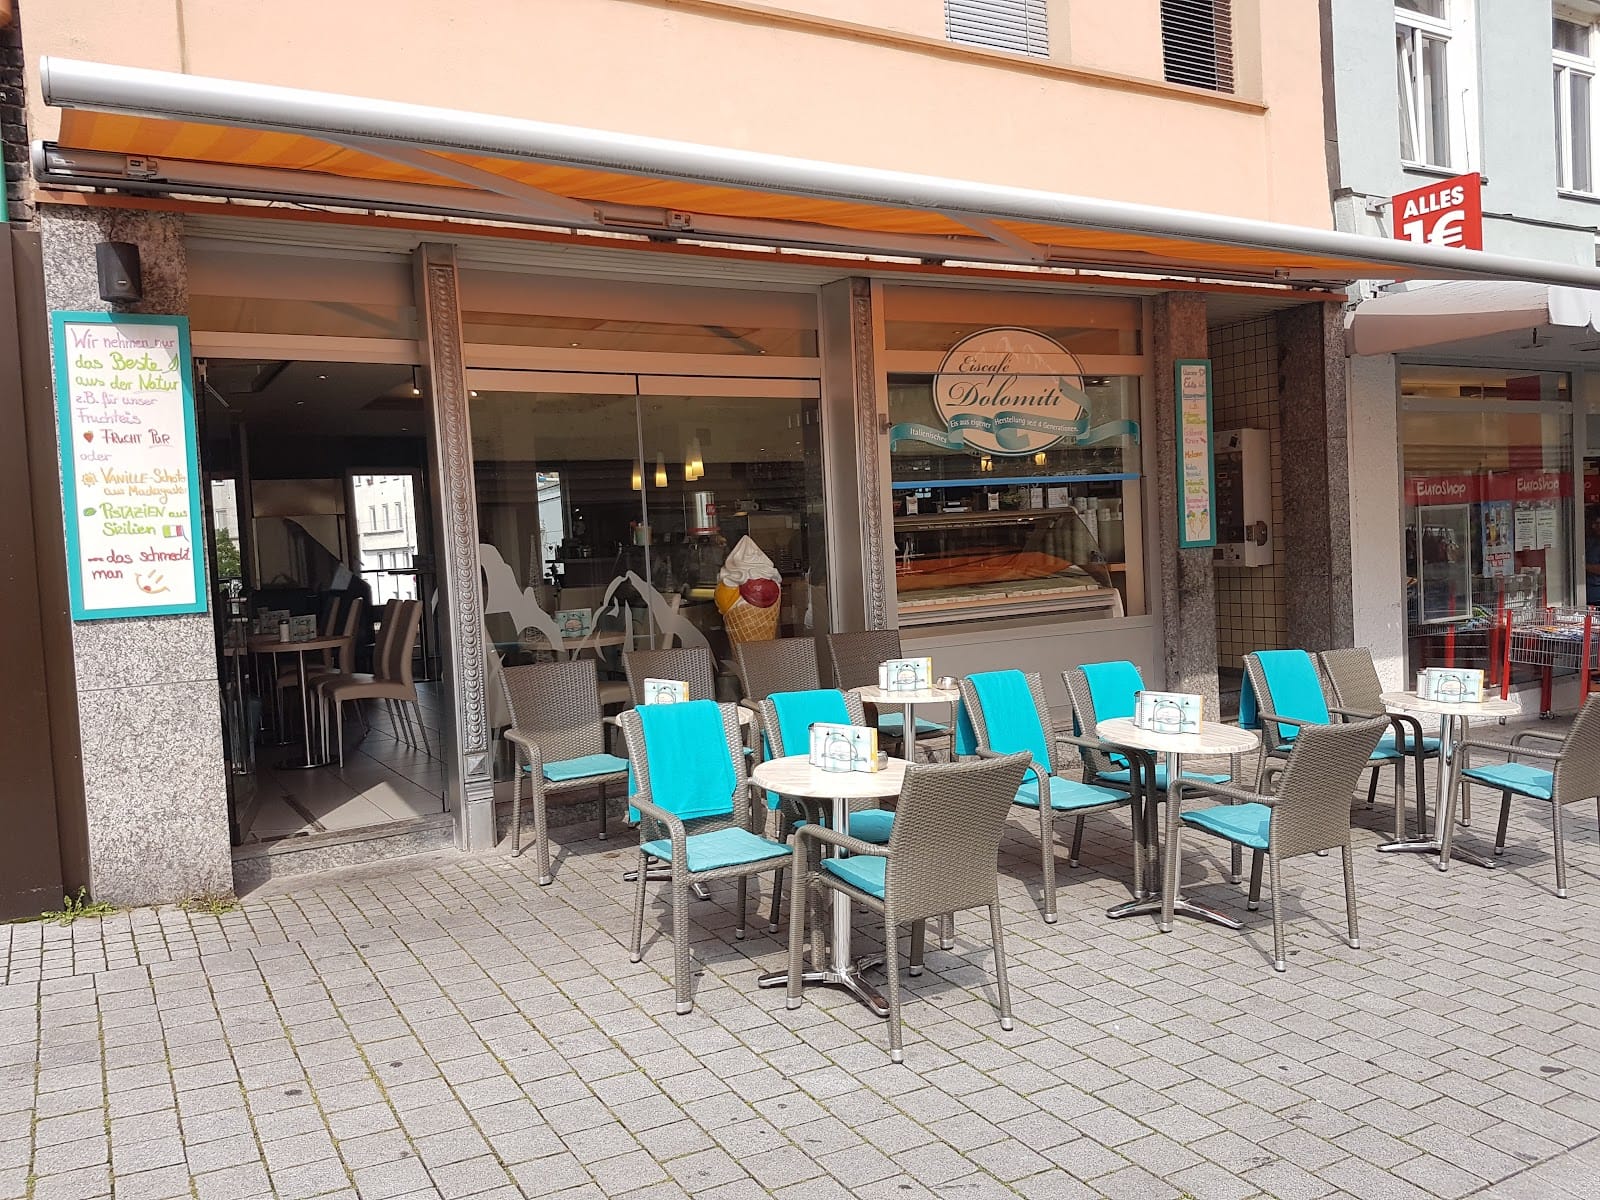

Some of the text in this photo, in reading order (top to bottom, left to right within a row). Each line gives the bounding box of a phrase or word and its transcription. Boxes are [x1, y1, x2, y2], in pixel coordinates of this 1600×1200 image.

[1403, 186, 1464, 219] ALLES
[71, 328, 175, 349] Wir nehmen nur
[75, 352, 162, 371] das Beste
[958, 352, 1013, 387] Eiscafé
[75, 374, 179, 391] aus der Natur
[945, 374, 1063, 407] Dolomiti
[102, 391, 117, 408] für
[122, 396, 158, 406] unser
[76, 408, 141, 424] Fruchteis
[909, 427, 947, 444] Italienisches
[80, 450, 112, 461] oder
[1416, 479, 1467, 496] EuroShop
[1517, 477, 1560, 492] EuroShop
[103, 521, 157, 536] Sizilien
[106, 546, 191, 564] das schmeckt
[92, 569, 124, 580] man
